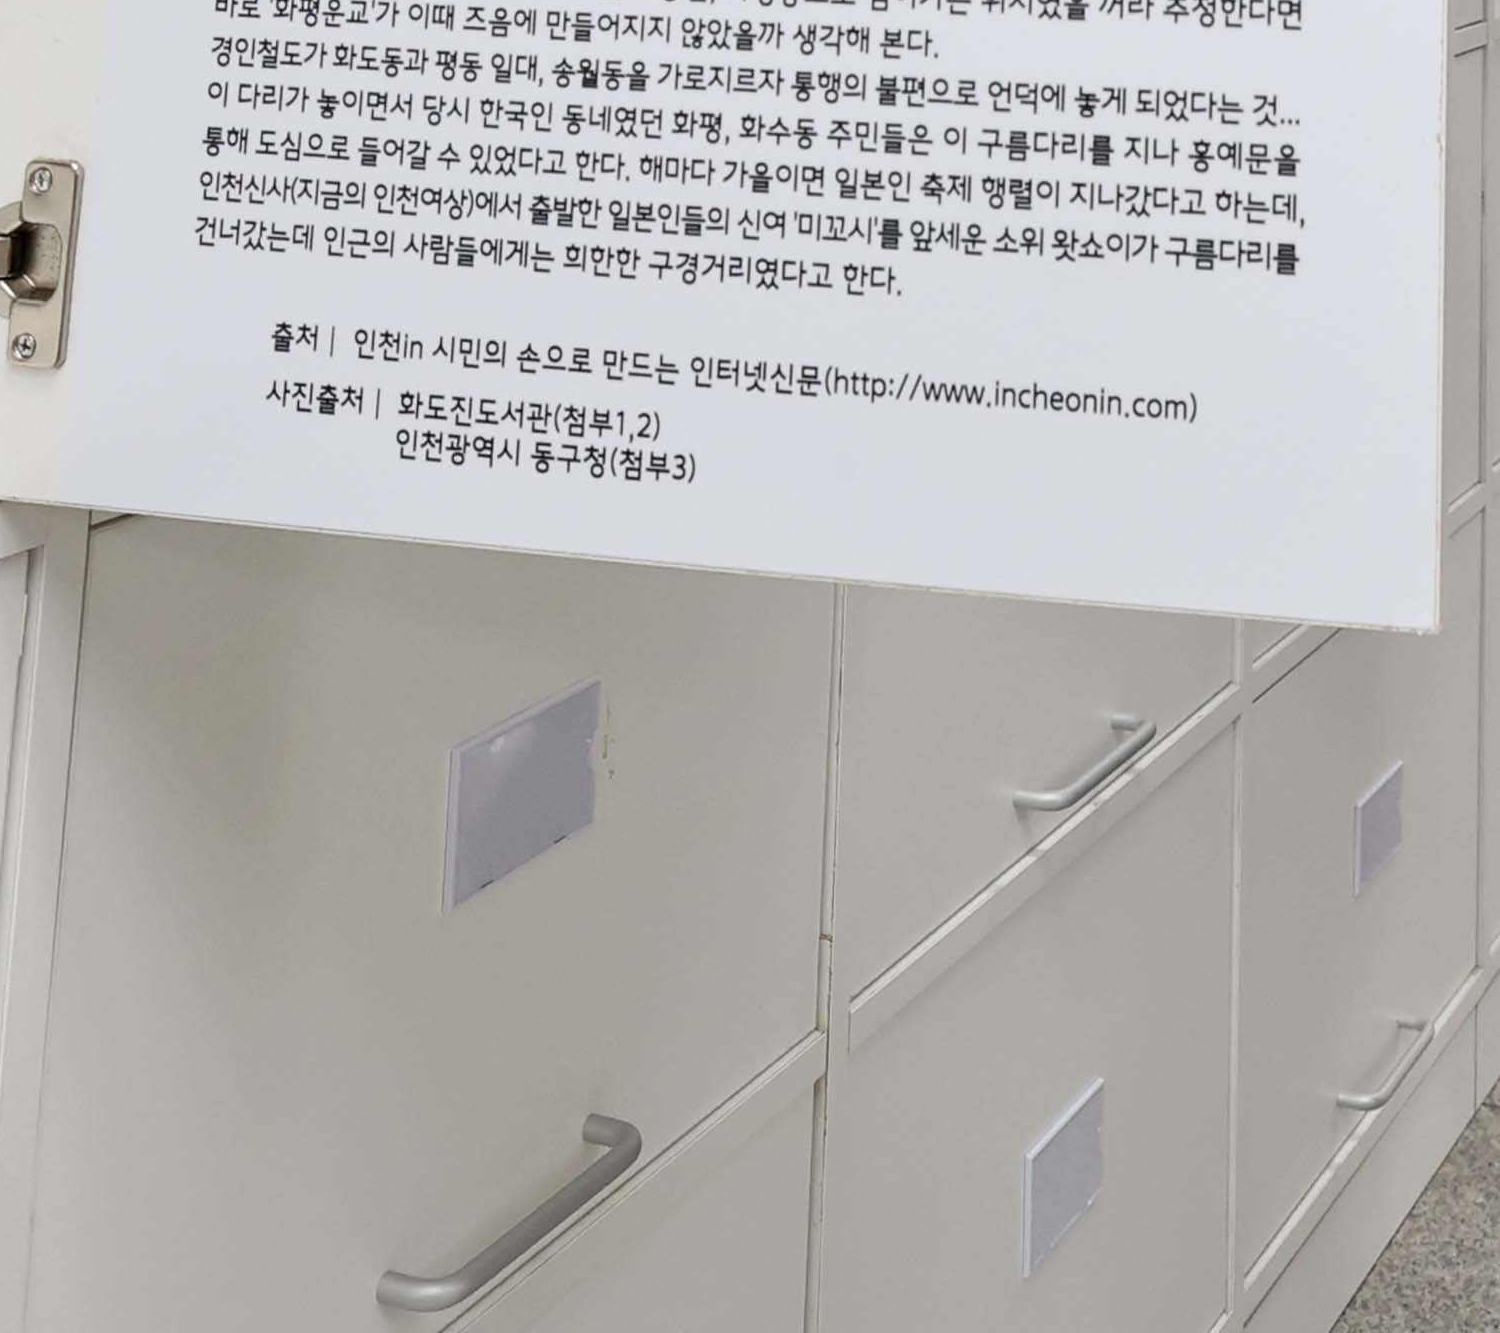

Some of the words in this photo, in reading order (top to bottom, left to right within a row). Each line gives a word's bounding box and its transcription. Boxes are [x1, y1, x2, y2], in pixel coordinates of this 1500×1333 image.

[408, 3, 455, 31] 이때
[463, 6, 537, 37] 즈음에
[546, 11, 671, 43] 만들어지지
[681, 18, 785, 51] 않았을까
[793, 24, 870, 56] 생각해
[879, 29, 938, 59] 본다.
[195, 216, 314, 253] 건너갔는데
[324, 226, 395, 259] 인근의
[403, 233, 555, 273] 사람들에게는
[563, 243, 641, 280] 희한한
[648, 251, 833, 290] 구경거리였다고
[843, 263, 902, 296] 한다.
[271, 321, 319, 353] 출처
[354, 329, 423, 362] 인천in
[432, 336, 506, 369] 시민의
[516, 343, 593, 374] 손으로
[603, 350, 679, 386] 만드는
[690, 356, 1197, 423] 인터넷신문(http://www.incheonin.com)
[266, 380, 364, 415] 사진출처
[398, 390, 660, 443] 화도진도서관(첨부1,2)
[396, 429, 520, 468] 인천광역시
[530, 441, 695, 483] 동구청(첨부3)
